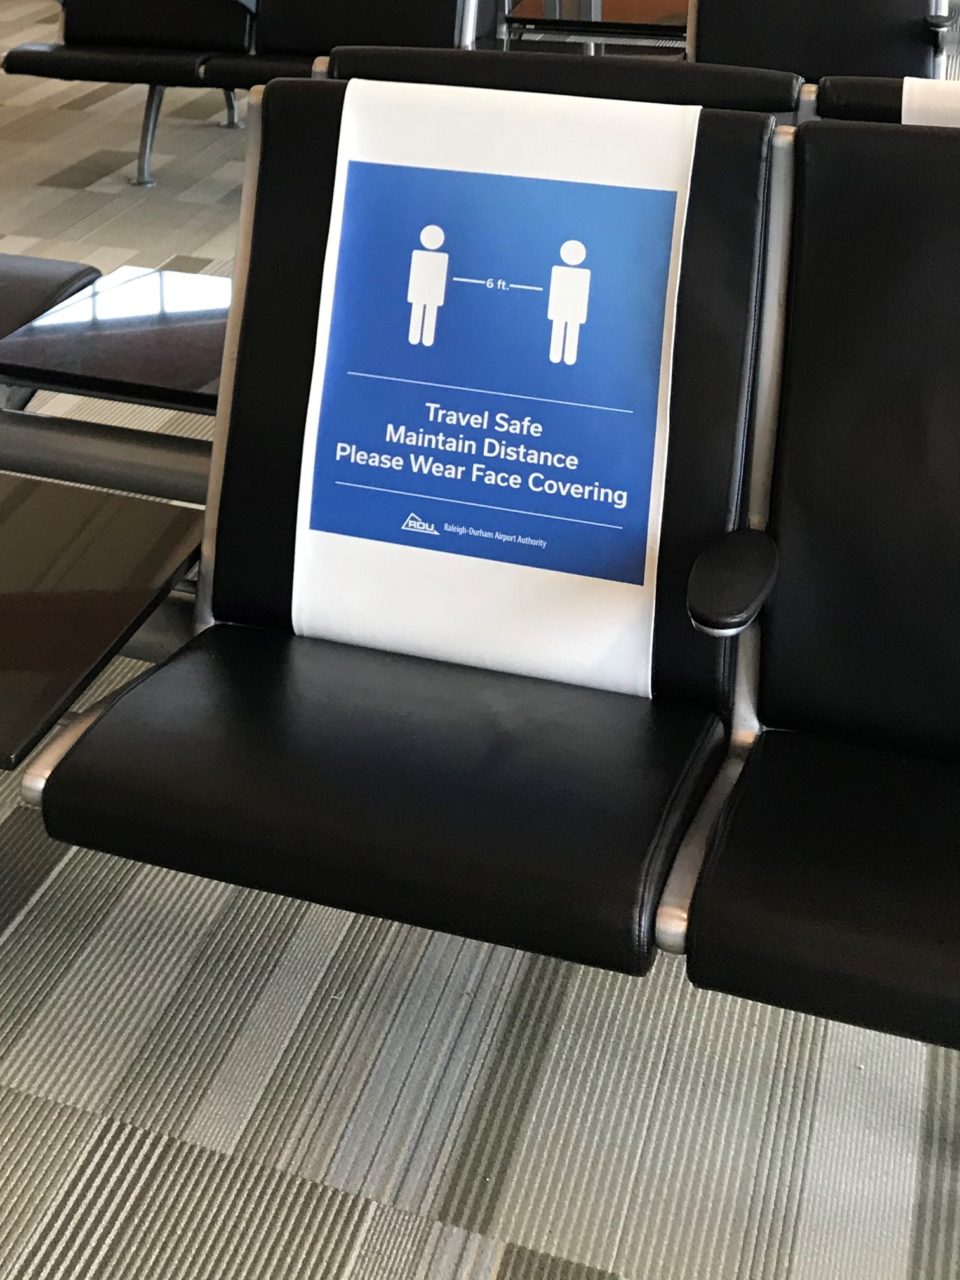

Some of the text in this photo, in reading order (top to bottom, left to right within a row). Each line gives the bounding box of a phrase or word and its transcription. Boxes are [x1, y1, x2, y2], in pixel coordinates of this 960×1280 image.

[485, 278, 510, 291] 6 ft.
[425, 402, 543, 437] Travel Safe
[385, 423, 579, 470] Maintain Distance
[335, 442, 628, 509] Please Wear Face Covering
[443, 522, 547, 549] Raleigh-Durham Airport Authority
